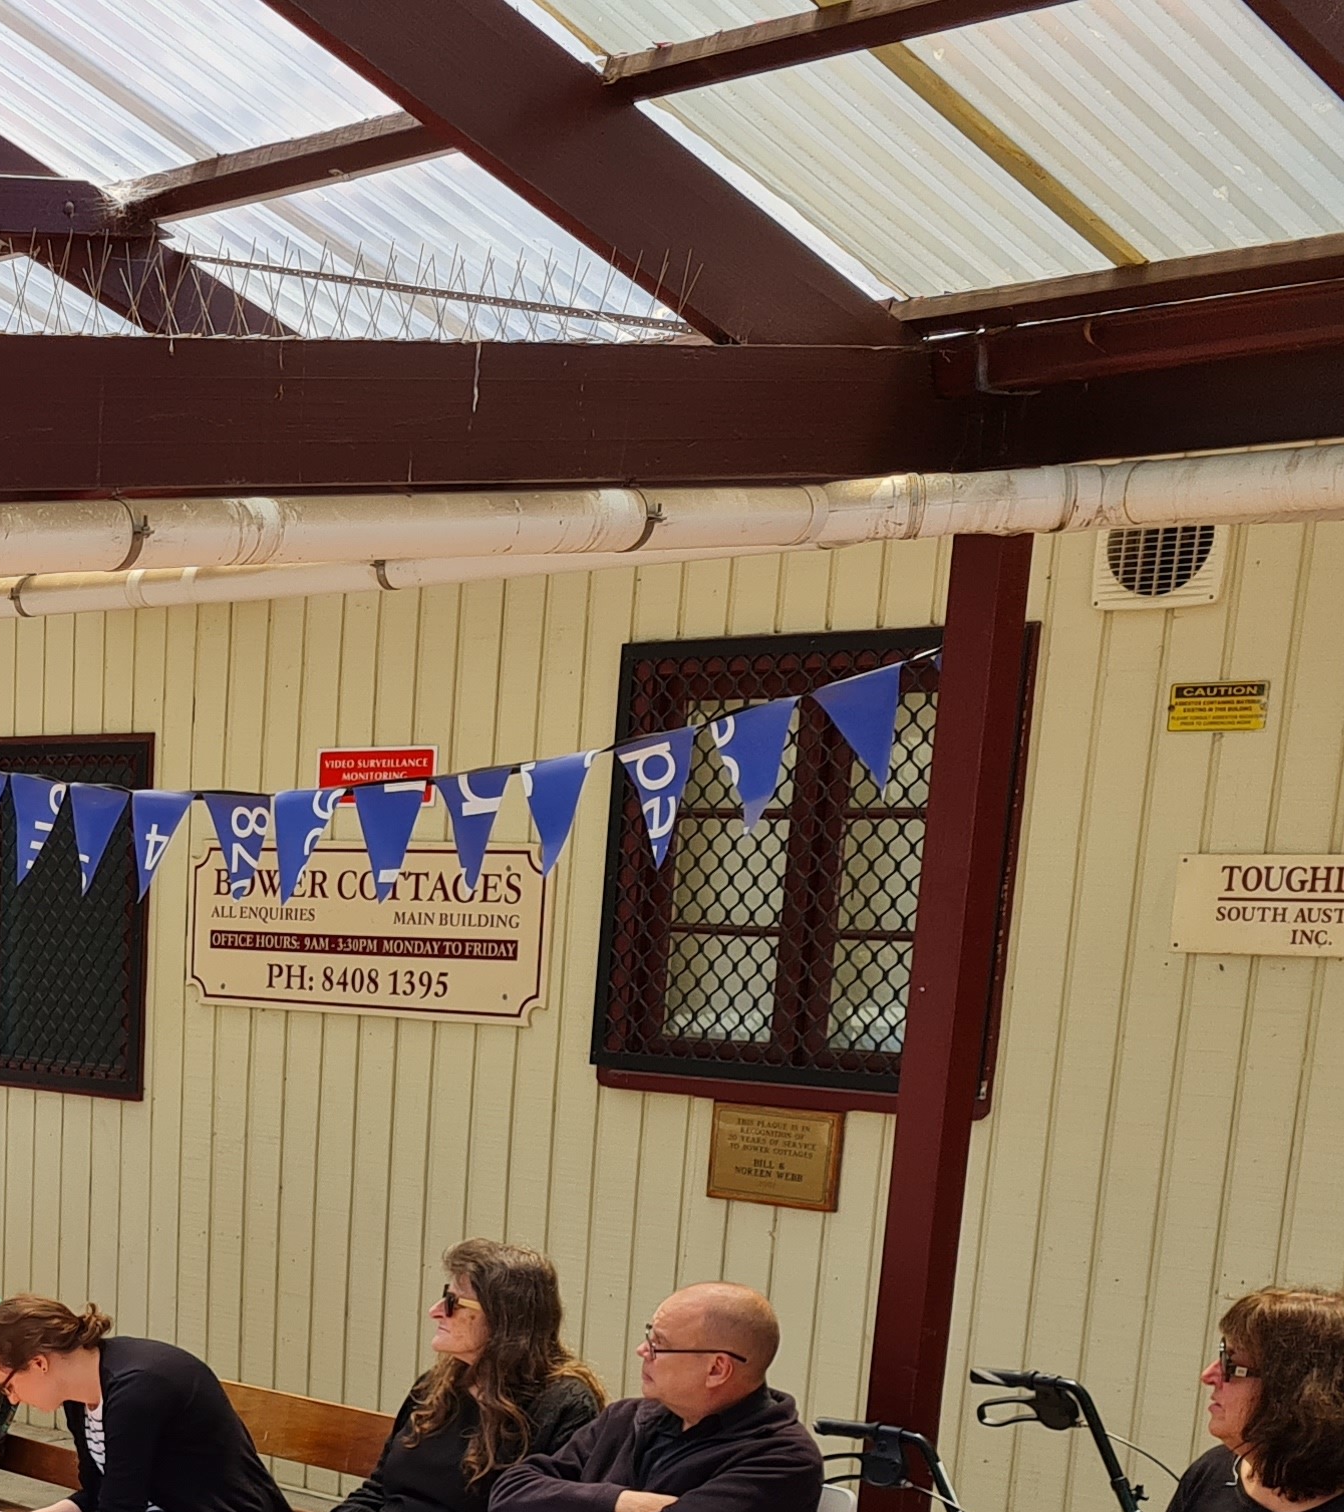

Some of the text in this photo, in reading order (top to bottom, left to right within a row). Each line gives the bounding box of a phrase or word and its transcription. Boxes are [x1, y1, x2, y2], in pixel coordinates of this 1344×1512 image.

[1183, 686, 1258, 696] CAUTION
[325, 758, 428, 769] VIDEO SURVEILLANCE
[342, 771, 408, 781] MONITORING
[211, 905, 316, 924] ALL ENQUIRIES
[393, 911, 520, 929] MAIN BUILDING
[1216, 906, 1288, 923] SOUTH
[212, 932, 254, 947] OFFICE
[255, 934, 301, 949] HOURS:
[304, 937, 329, 951] 9AM
[337, 938, 377, 953] 3:30PM
[382, 939, 441, 955] MONDAY
[443, 941, 462, 955] TO
[464, 942, 516, 957] FRIDAY
[1290, 929, 1333, 946] INC.
[266, 963, 449, 999] PH: 8408 1395
[753, 1159, 774, 1169] BILL
[735, 1166, 803, 1182] NOREEN WEBB
